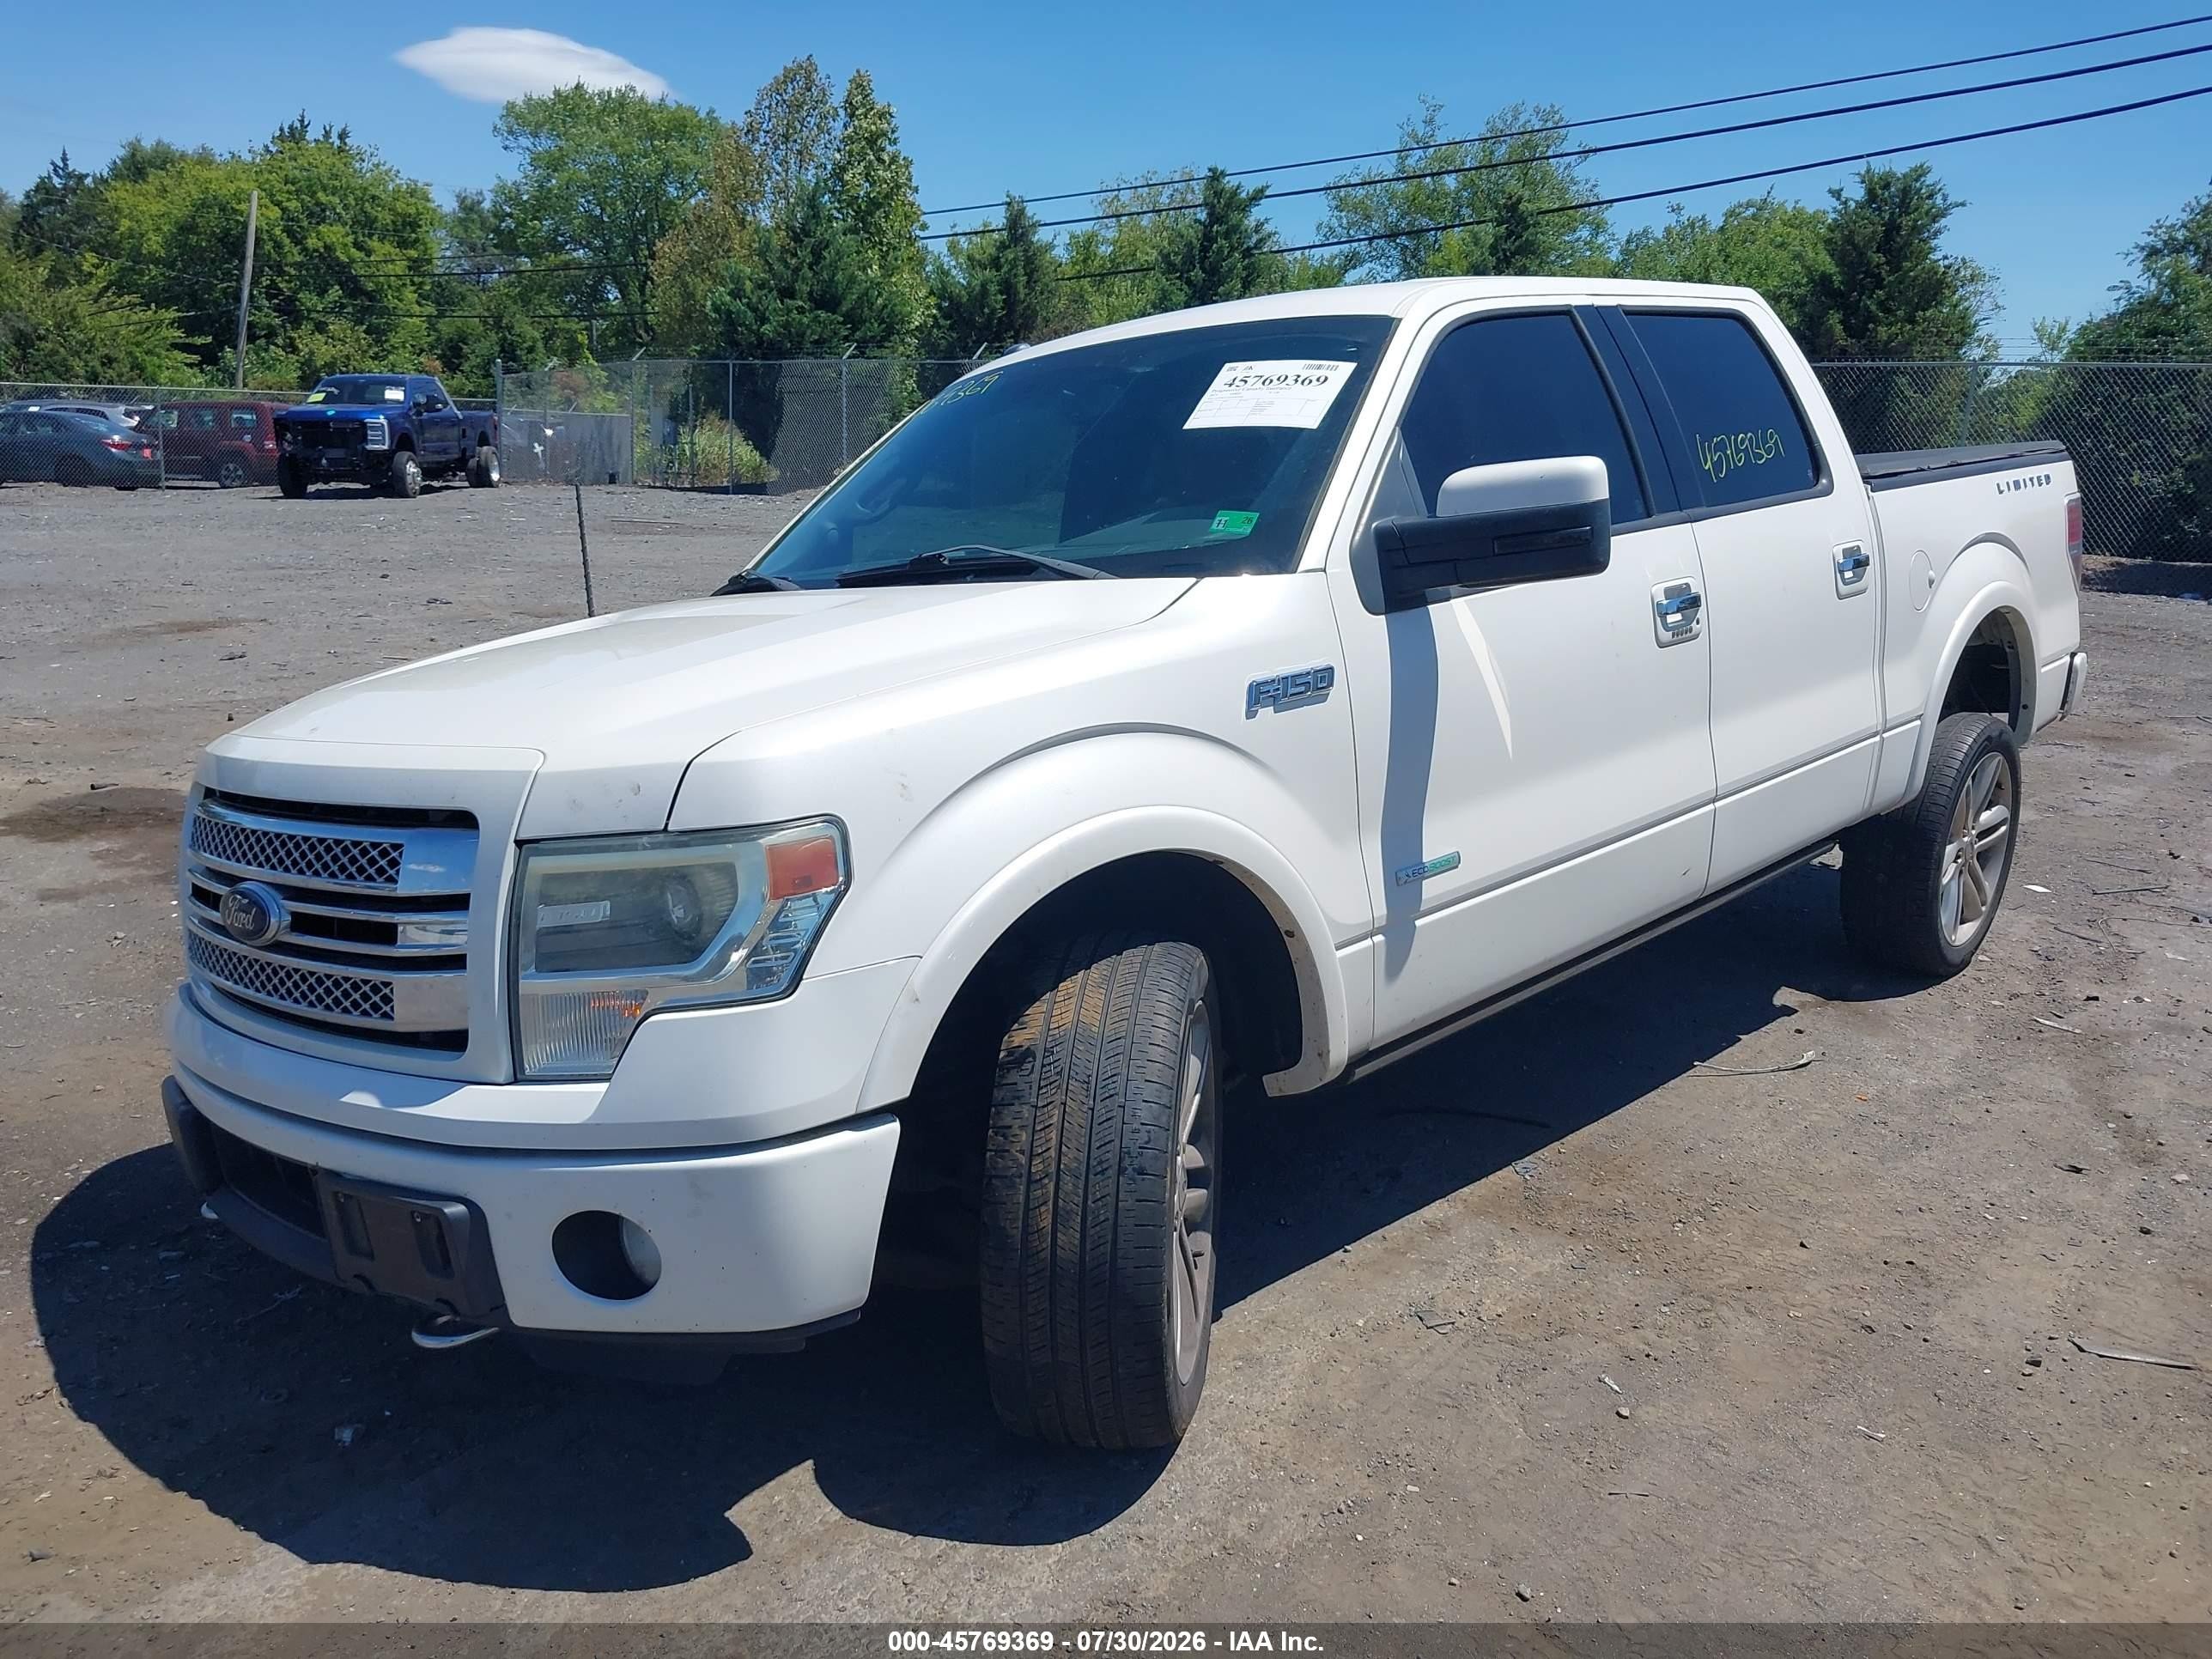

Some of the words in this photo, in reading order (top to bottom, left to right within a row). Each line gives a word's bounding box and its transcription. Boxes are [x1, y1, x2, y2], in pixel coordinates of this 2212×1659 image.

[1223, 373, 1329, 389] 45769369
[1696, 428, 1785, 483] 45769369
[1996, 473, 2051, 495] LIMITED
[225, 894, 257, 930] Ford
